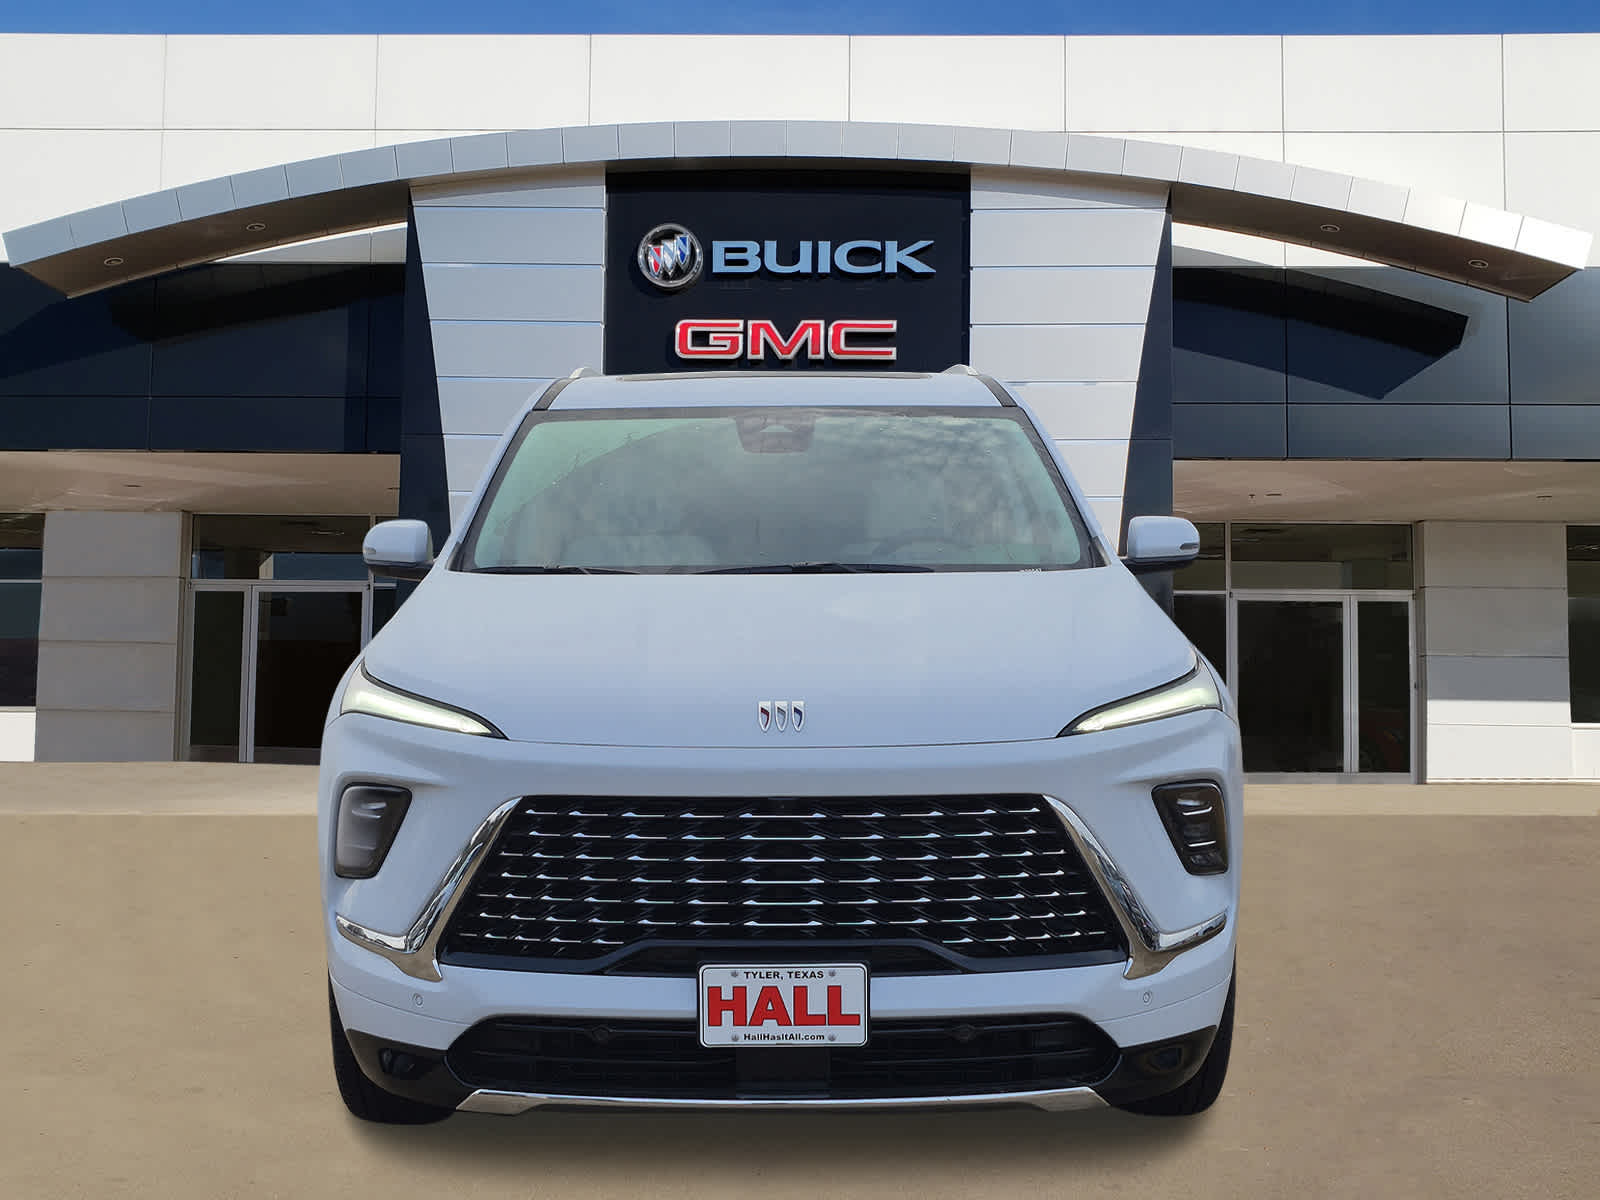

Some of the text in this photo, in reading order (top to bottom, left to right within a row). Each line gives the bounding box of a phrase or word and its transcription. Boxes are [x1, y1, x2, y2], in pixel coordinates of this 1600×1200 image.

[712, 240, 937, 273] BUICK
[675, 319, 897, 360] GMC
[744, 970, 824, 980] TYLER, TEXAS
[707, 985, 861, 1027] HALL
[743, 1033, 825, 1041] HallHasItAll.com
